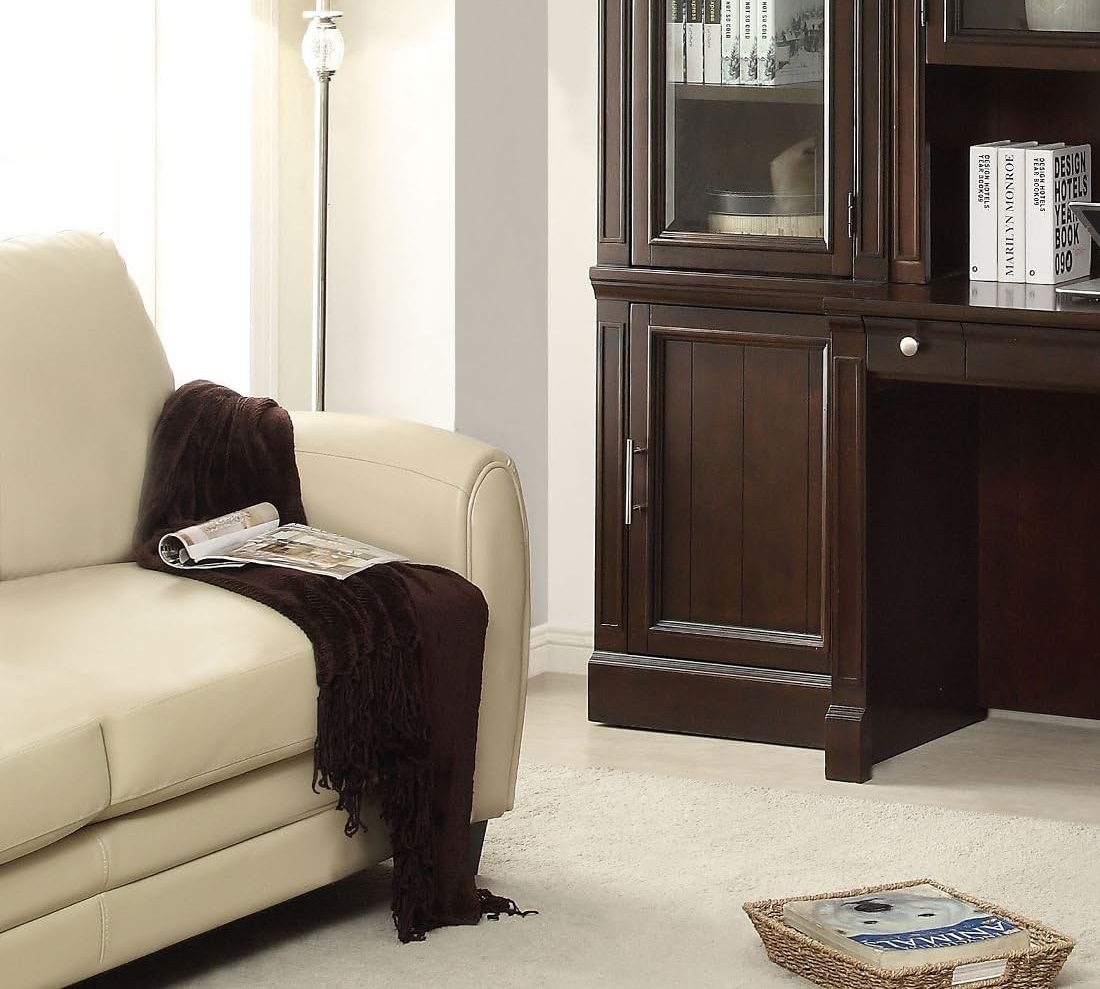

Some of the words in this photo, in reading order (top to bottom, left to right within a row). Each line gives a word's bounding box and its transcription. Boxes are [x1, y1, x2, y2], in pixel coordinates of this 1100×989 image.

[1055, 151, 1086, 178] DESIGN
[1005, 154, 1014, 211] MONROE
[1055, 175, 1088, 202] HOTELS
[1005, 215, 1014, 276] MARILYN
[1055, 223, 1079, 249] BOOK
[863, 920, 1005, 950] ANIMALS
